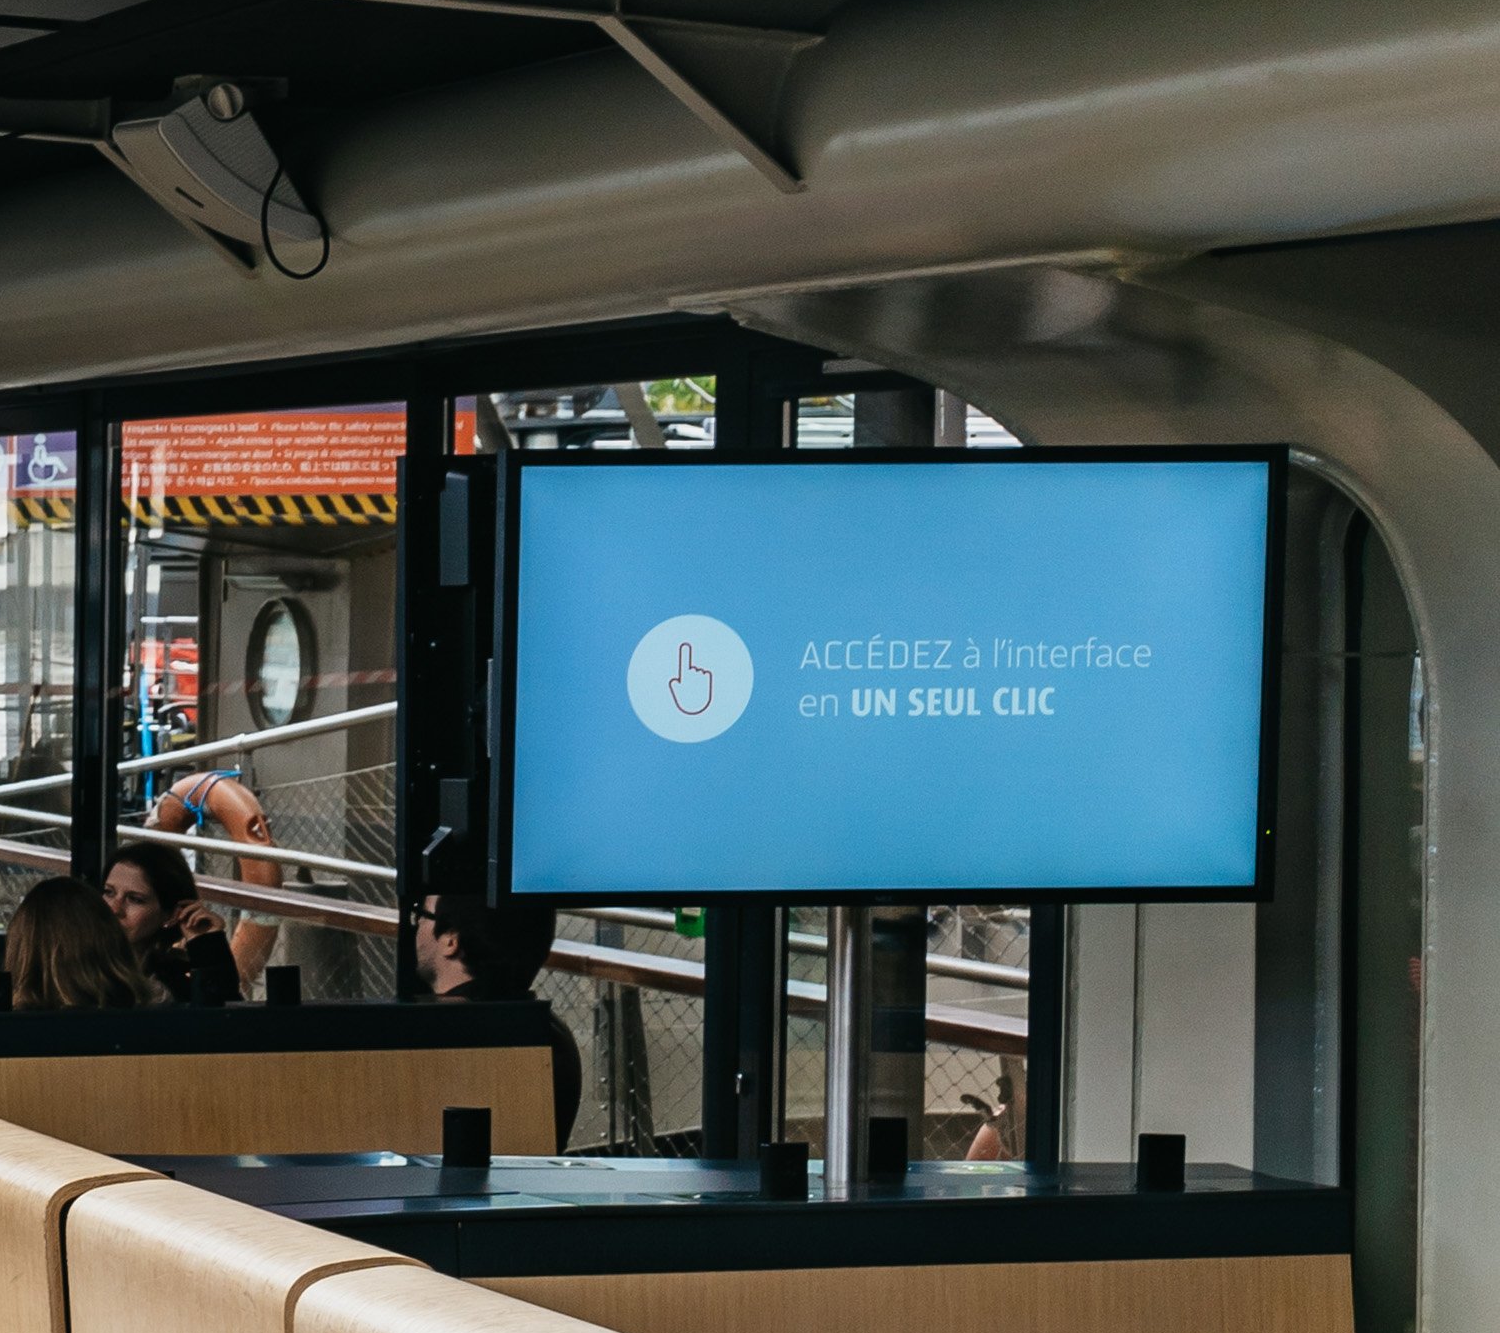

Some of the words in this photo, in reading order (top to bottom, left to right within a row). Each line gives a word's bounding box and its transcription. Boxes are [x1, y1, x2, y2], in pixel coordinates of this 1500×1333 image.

[271, 422, 299, 432] Please
[799, 633, 953, 670] ACCÉDEZ
[962, 637, 981, 669] à
[993, 636, 1153, 669] l'interface
[799, 694, 839, 718] en
[851, 687, 896, 717] UN
[908, 687, 981, 717] SEUL
[992, 687, 1056, 716] CLIC
